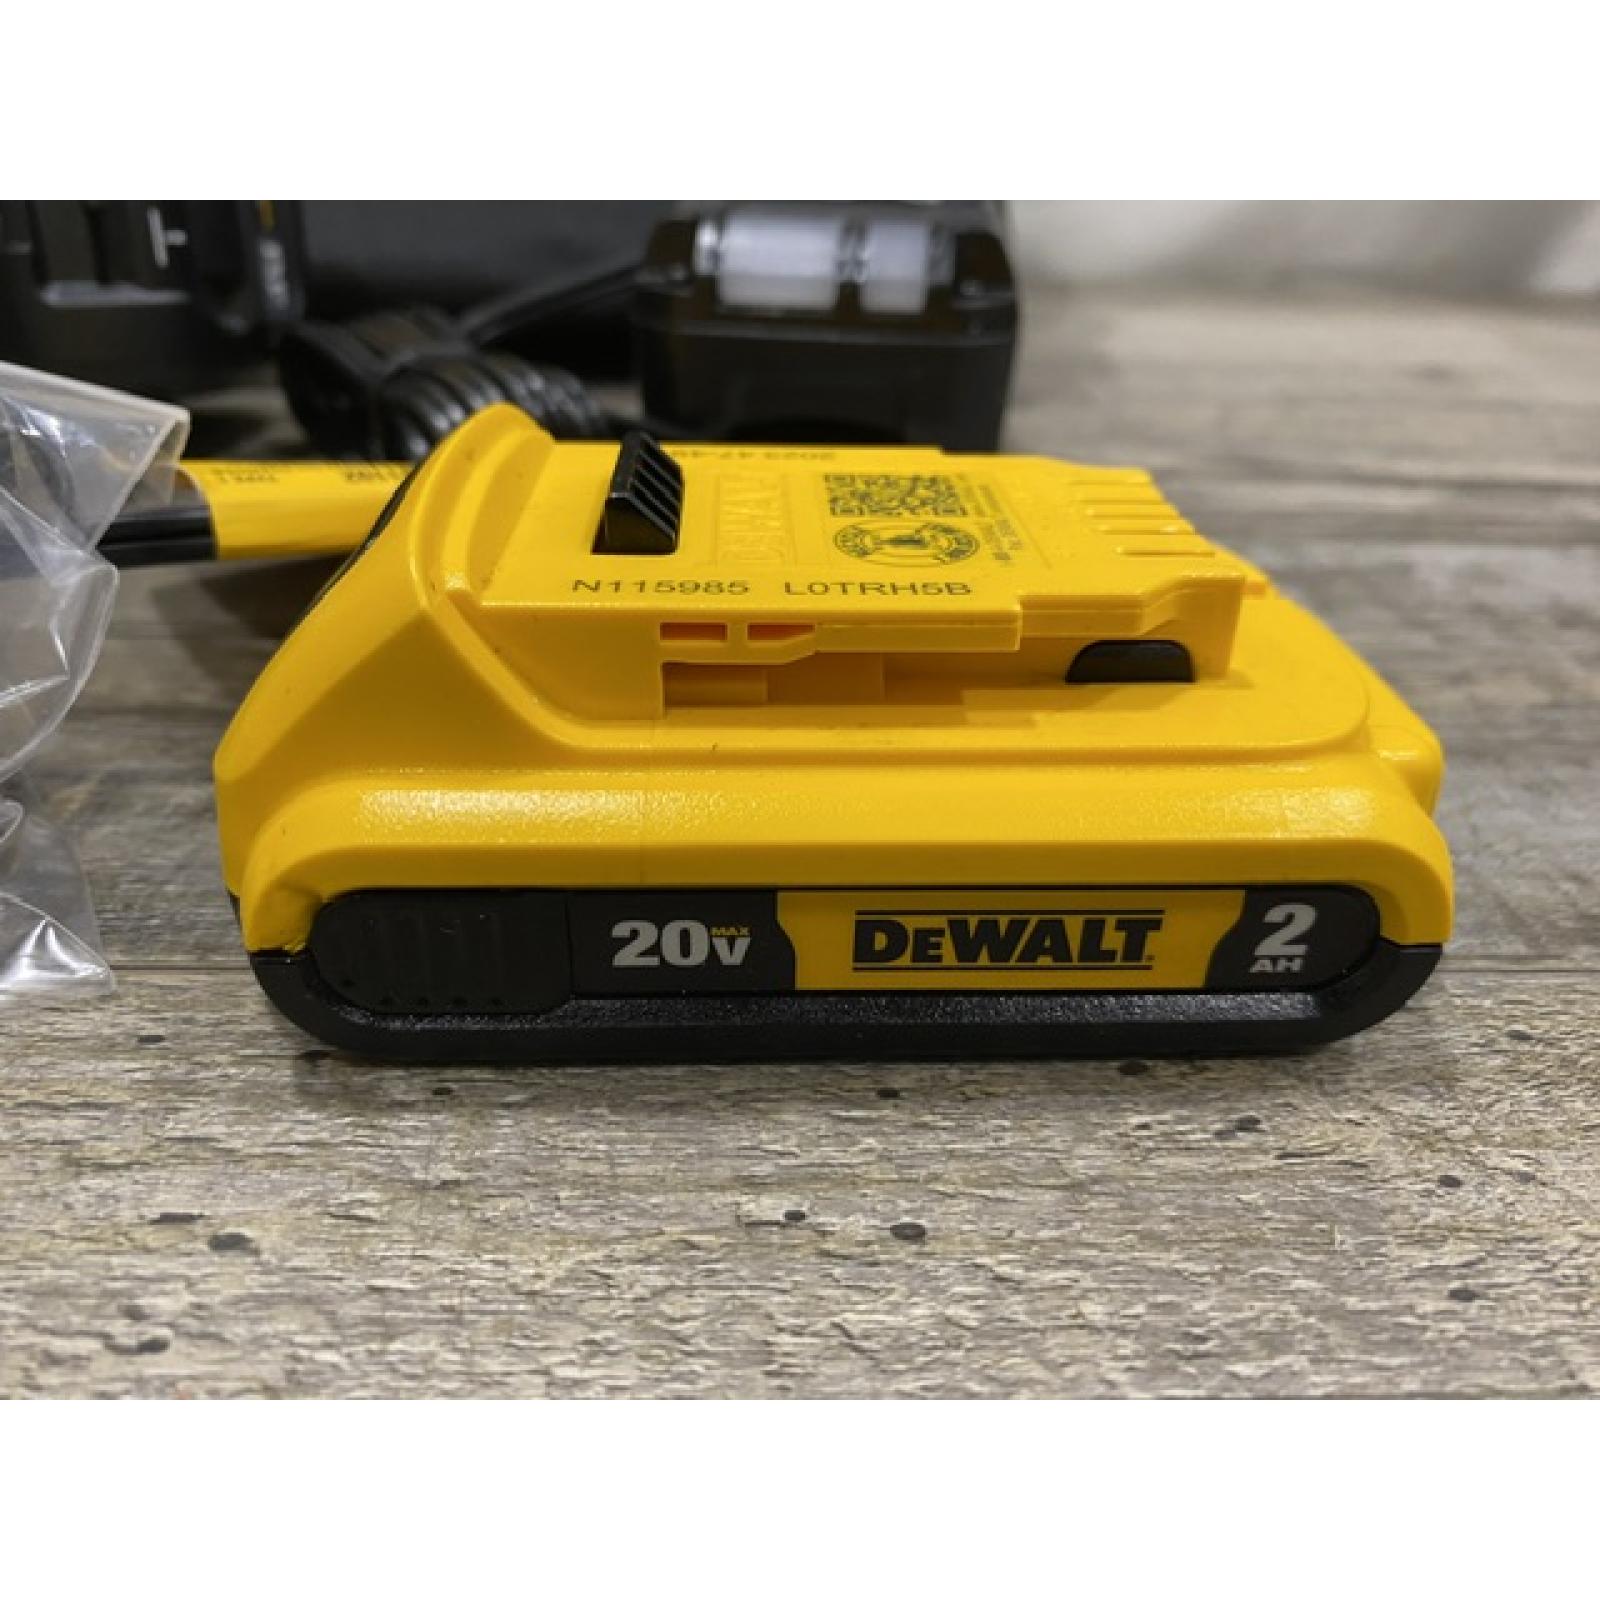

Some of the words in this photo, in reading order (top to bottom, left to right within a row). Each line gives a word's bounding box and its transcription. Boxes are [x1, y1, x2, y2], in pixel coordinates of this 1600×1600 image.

[571, 578, 751, 595] N115985
[710, 926, 750, 937] MAX
[1253, 903, 1317, 956] 2
[1249, 957, 1304, 974] AH
